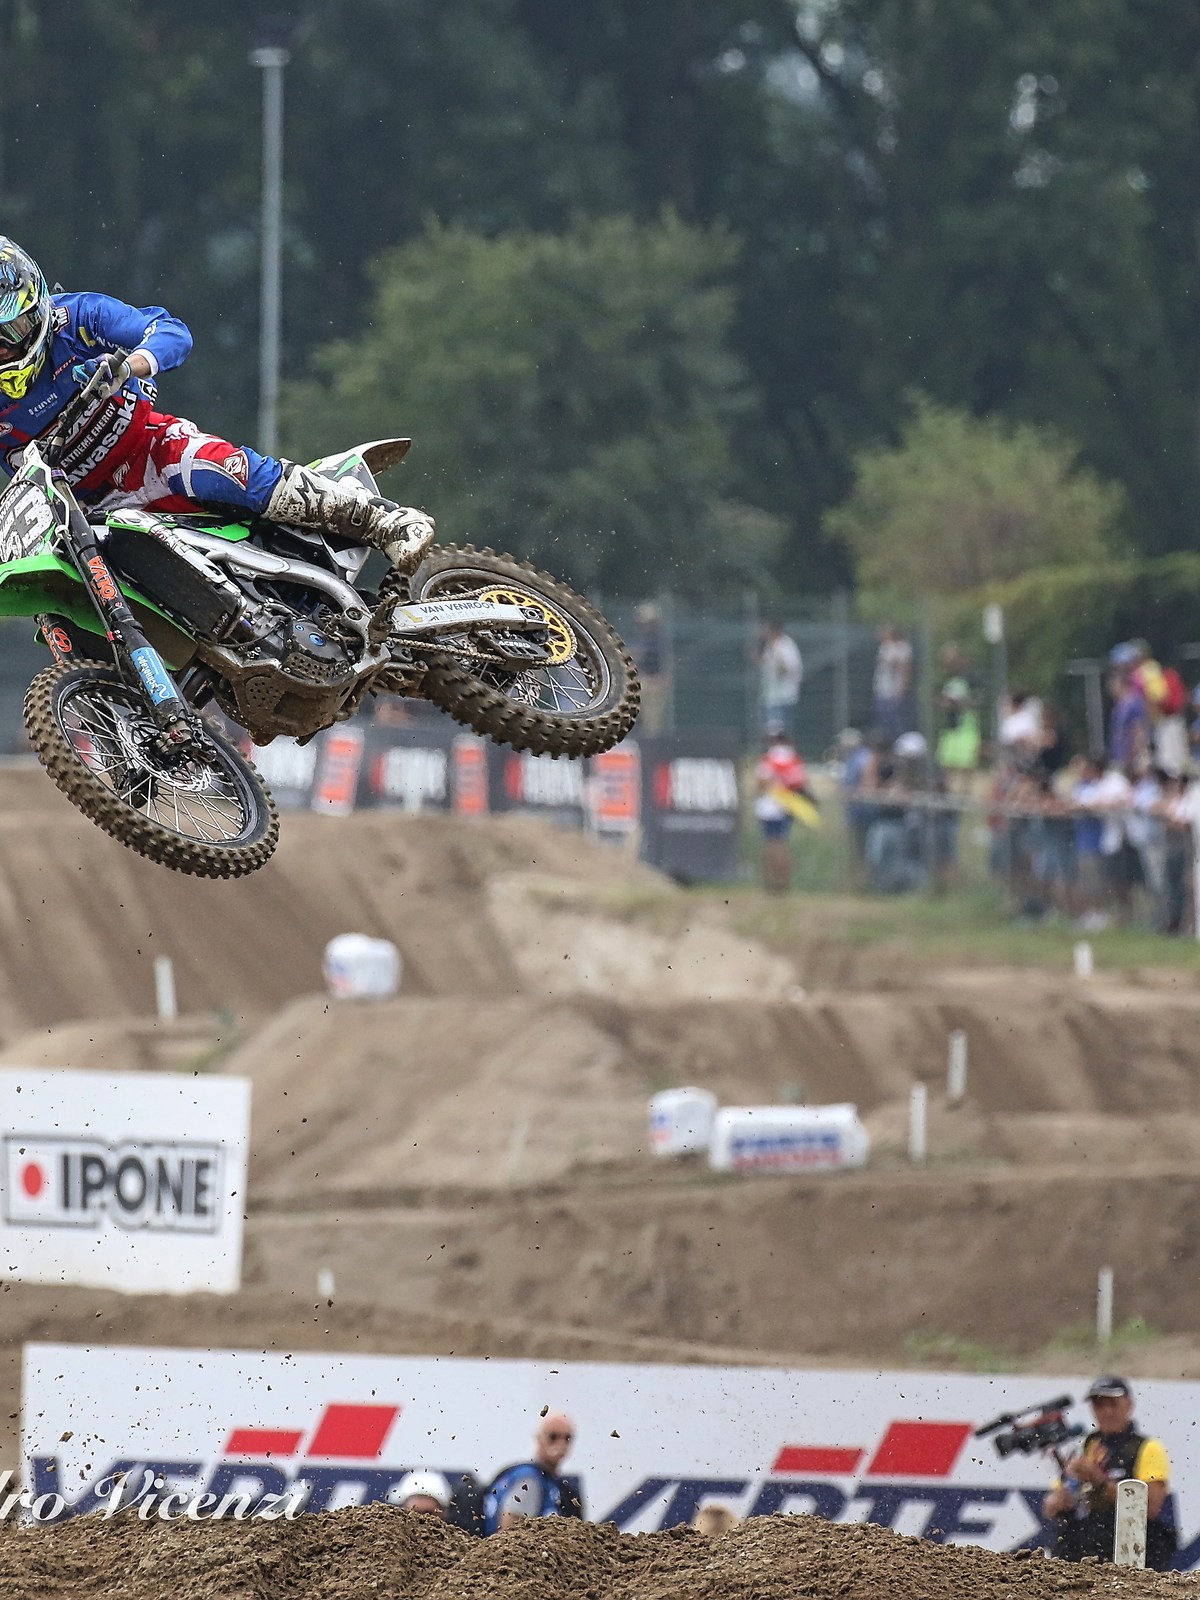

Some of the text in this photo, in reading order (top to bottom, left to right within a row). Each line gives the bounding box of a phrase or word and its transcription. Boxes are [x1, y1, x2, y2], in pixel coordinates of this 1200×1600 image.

[60, 434, 95, 468] EXTREME
[91, 402, 116, 437] ENERGY
[68, 388, 137, 487] awasaki
[420, 604, 444, 614] VAN
[62, 1153, 211, 1216] IPONE
